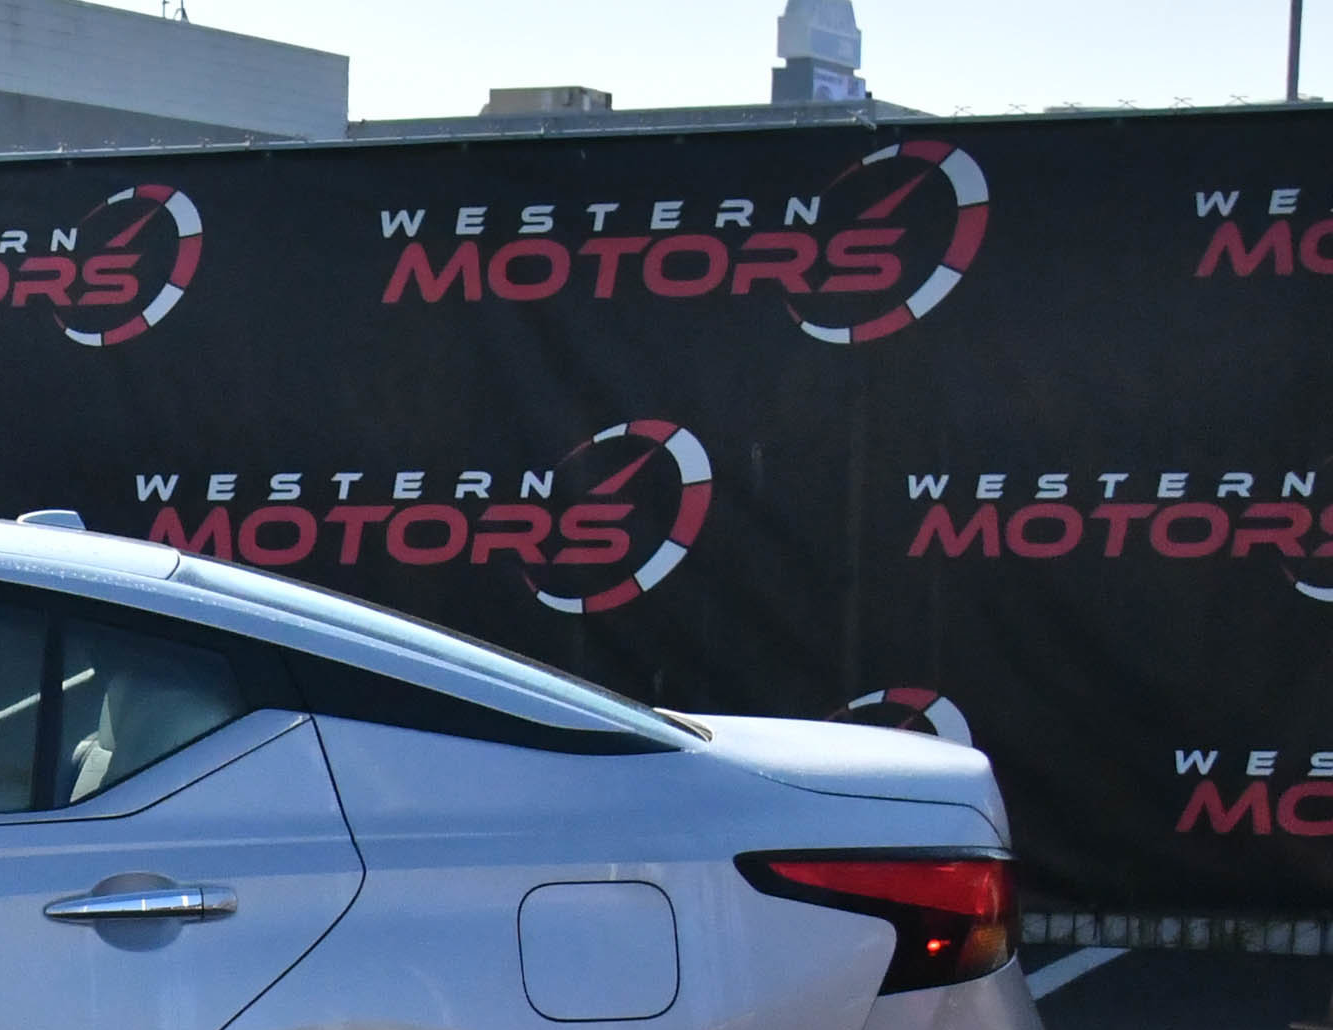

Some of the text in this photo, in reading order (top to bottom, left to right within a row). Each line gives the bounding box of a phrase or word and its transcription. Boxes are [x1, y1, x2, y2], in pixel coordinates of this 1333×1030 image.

[380, 195, 821, 239] WESTERN
[381, 227, 907, 304] MOTORS
[135, 469, 554, 502] WESTERN
[907, 470, 1317, 501] WESTERN
[145, 502, 636, 567] MOTORS
[907, 501, 1333, 559] MOTOR
